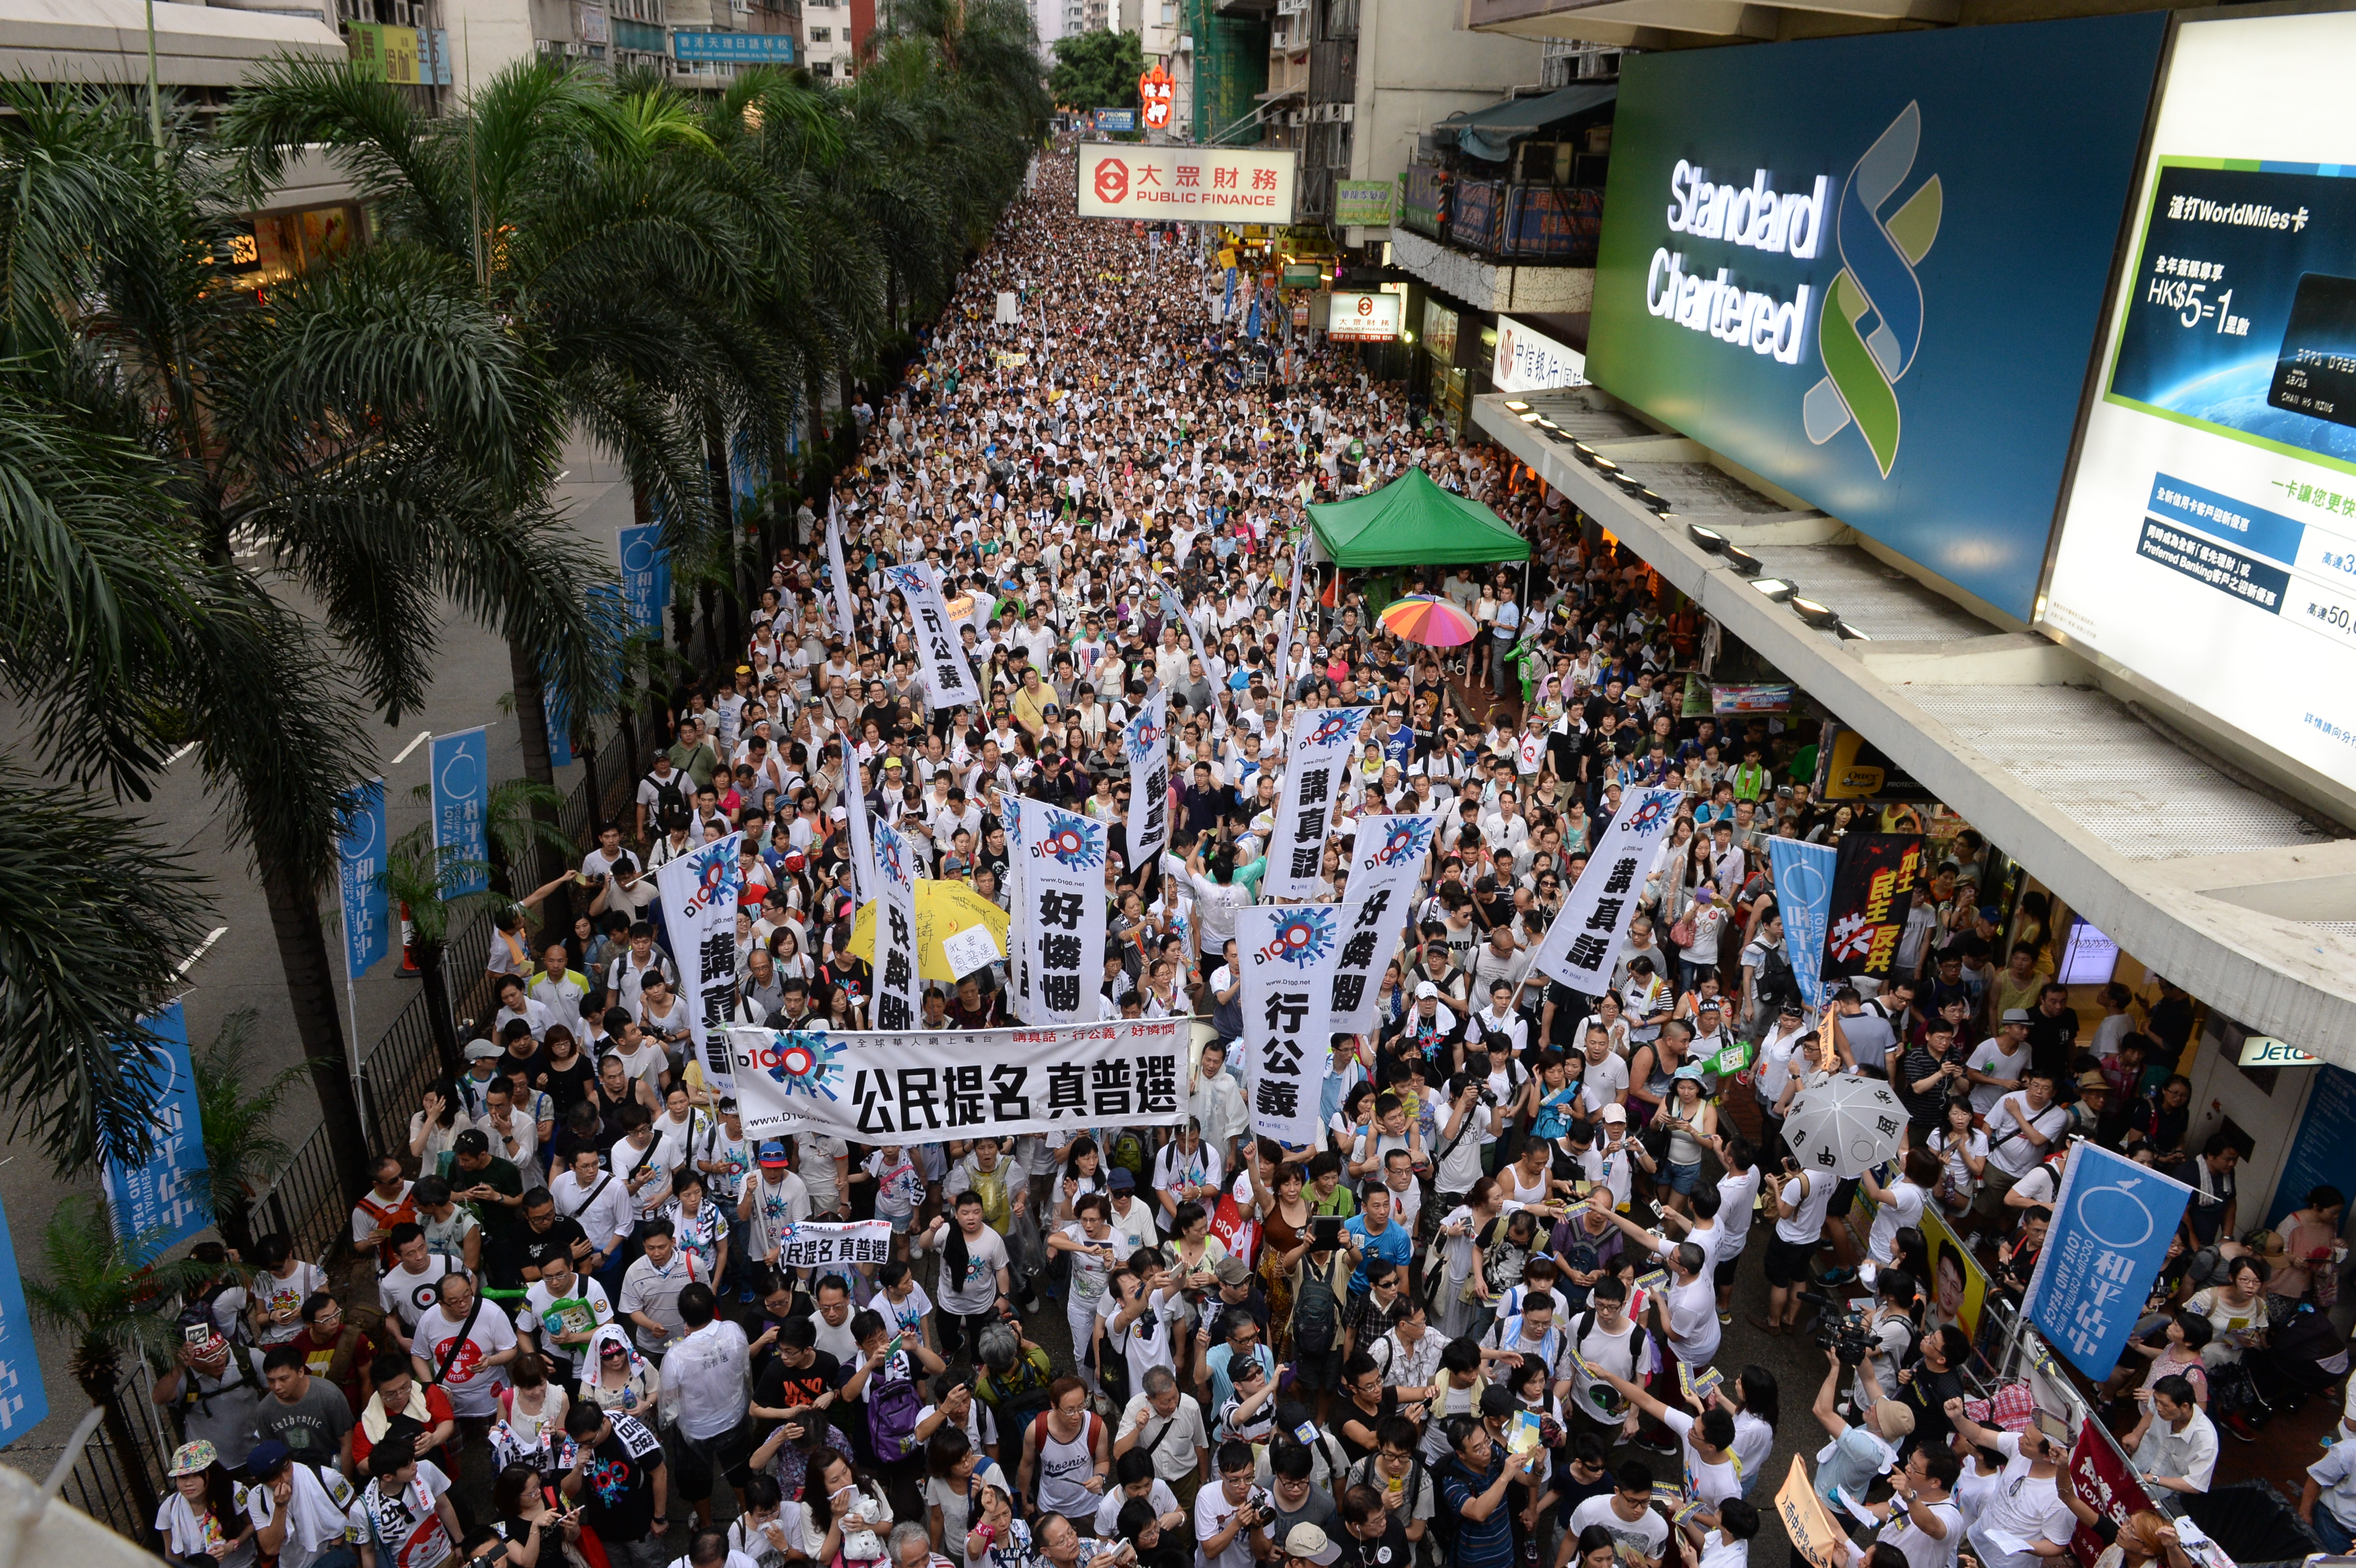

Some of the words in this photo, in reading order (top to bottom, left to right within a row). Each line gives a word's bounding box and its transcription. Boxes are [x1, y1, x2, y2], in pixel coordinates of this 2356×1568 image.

[1137, 164, 1278, 191] 大眾財務
[1137, 191, 1196, 203] PUBLIC
[1201, 193, 1276, 206] FINANCE
[1667, 159, 1828, 260] Standard
[2168, 195, 2309, 232] 渣打WorldMiles卡
[1339, 318, 1389, 327] 大眾財務
[1647, 247, 1811, 364] Chartered
[2157, 486, 2251, 533] 全新信用卡客戶迎新優惠
[2143, 540, 2180, 564] Preferred
[1299, 719, 1347, 751] D100
[444, 805, 453, 832] LOVE
[1290, 767, 1331, 880] 講真話
[1032, 830, 1081, 859] D100
[1364, 831, 1410, 871] D100
[683, 862, 723, 919] D100
[1040, 877, 1085, 887] www.D100.net
[1896, 852, 1920, 894] 本土
[1564, 857, 1640, 973] 講真話
[1865, 871, 1898, 924] 民主
[954, 943, 995, 971] 真普選
[1038, 889, 1084, 1013] 好憐憫
[1253, 924, 1311, 967] D100
[1331, 889, 1391, 1013] 好憐憫
[1864, 925, 1901, 972] 反共
[1265, 979, 1311, 987] www.D100.net
[857, 1035, 993, 1048] 全球華人網上電台
[1255, 991, 1309, 1119] 行公義
[737, 1046, 812, 1076] D100
[852, 1064, 1030, 1133] 公民提名
[1047, 1055, 1176, 1119] 真普選
[141, 1167, 153, 1214] CENTRAL
[837, 1237, 888, 1263] 真普選
[1216, 1219, 1244, 1251] D100
[2060, 1229, 2083, 1262] LOVE
[2055, 1261, 2071, 1289] AND
[2077, 1238, 2094, 1277] OCCUPY
[2042, 1290, 2065, 1328] PEACE
[2066, 1277, 2082, 1314] CENTRAL
[2066, 1249, 2136, 1357] 和平佔中
[2057, 1312, 2070, 1337] WITH
[447, 1372, 467, 1381] HERE
[2078, 1482, 2105, 1513] Joyo
